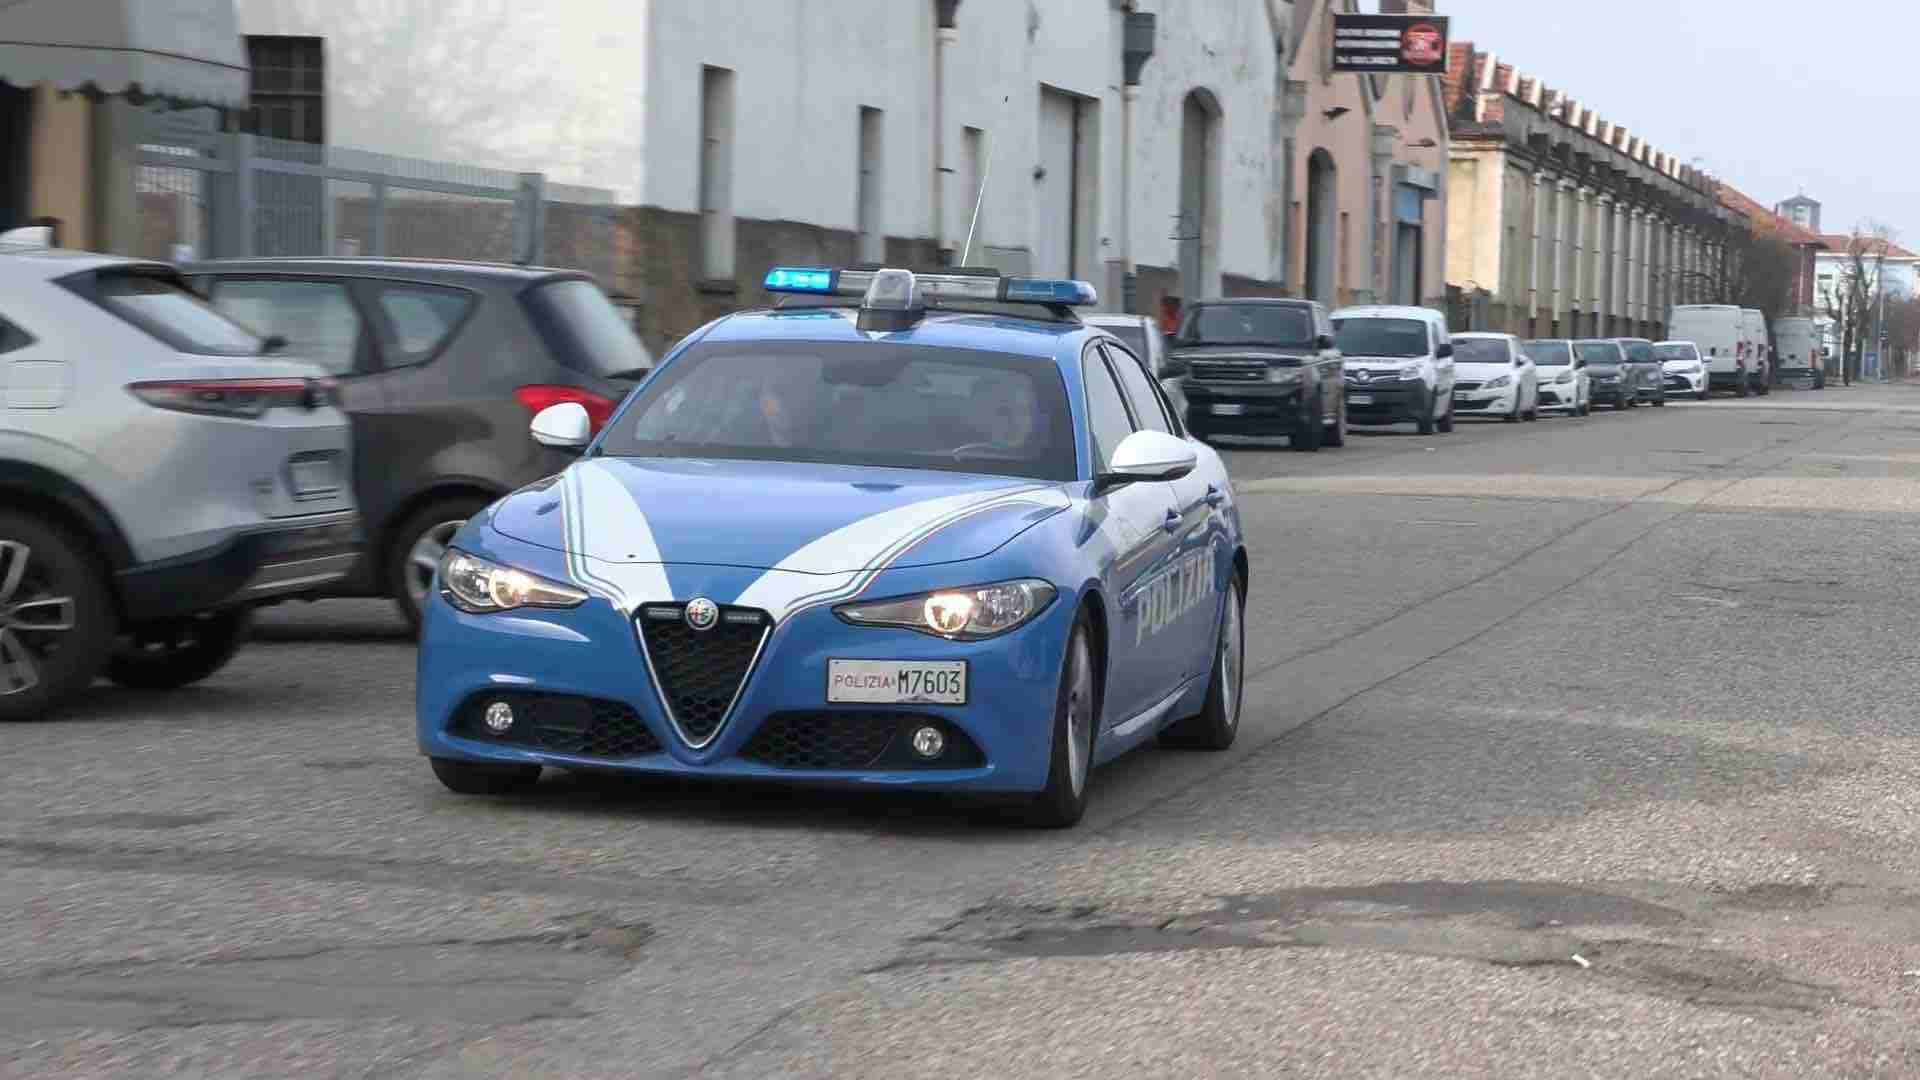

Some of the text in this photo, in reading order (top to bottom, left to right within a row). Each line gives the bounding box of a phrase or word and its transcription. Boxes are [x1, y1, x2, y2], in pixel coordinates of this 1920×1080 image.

[1135, 552, 1215, 648] POLIZIA
[834, 670, 960, 694] POLIZIA M7603
